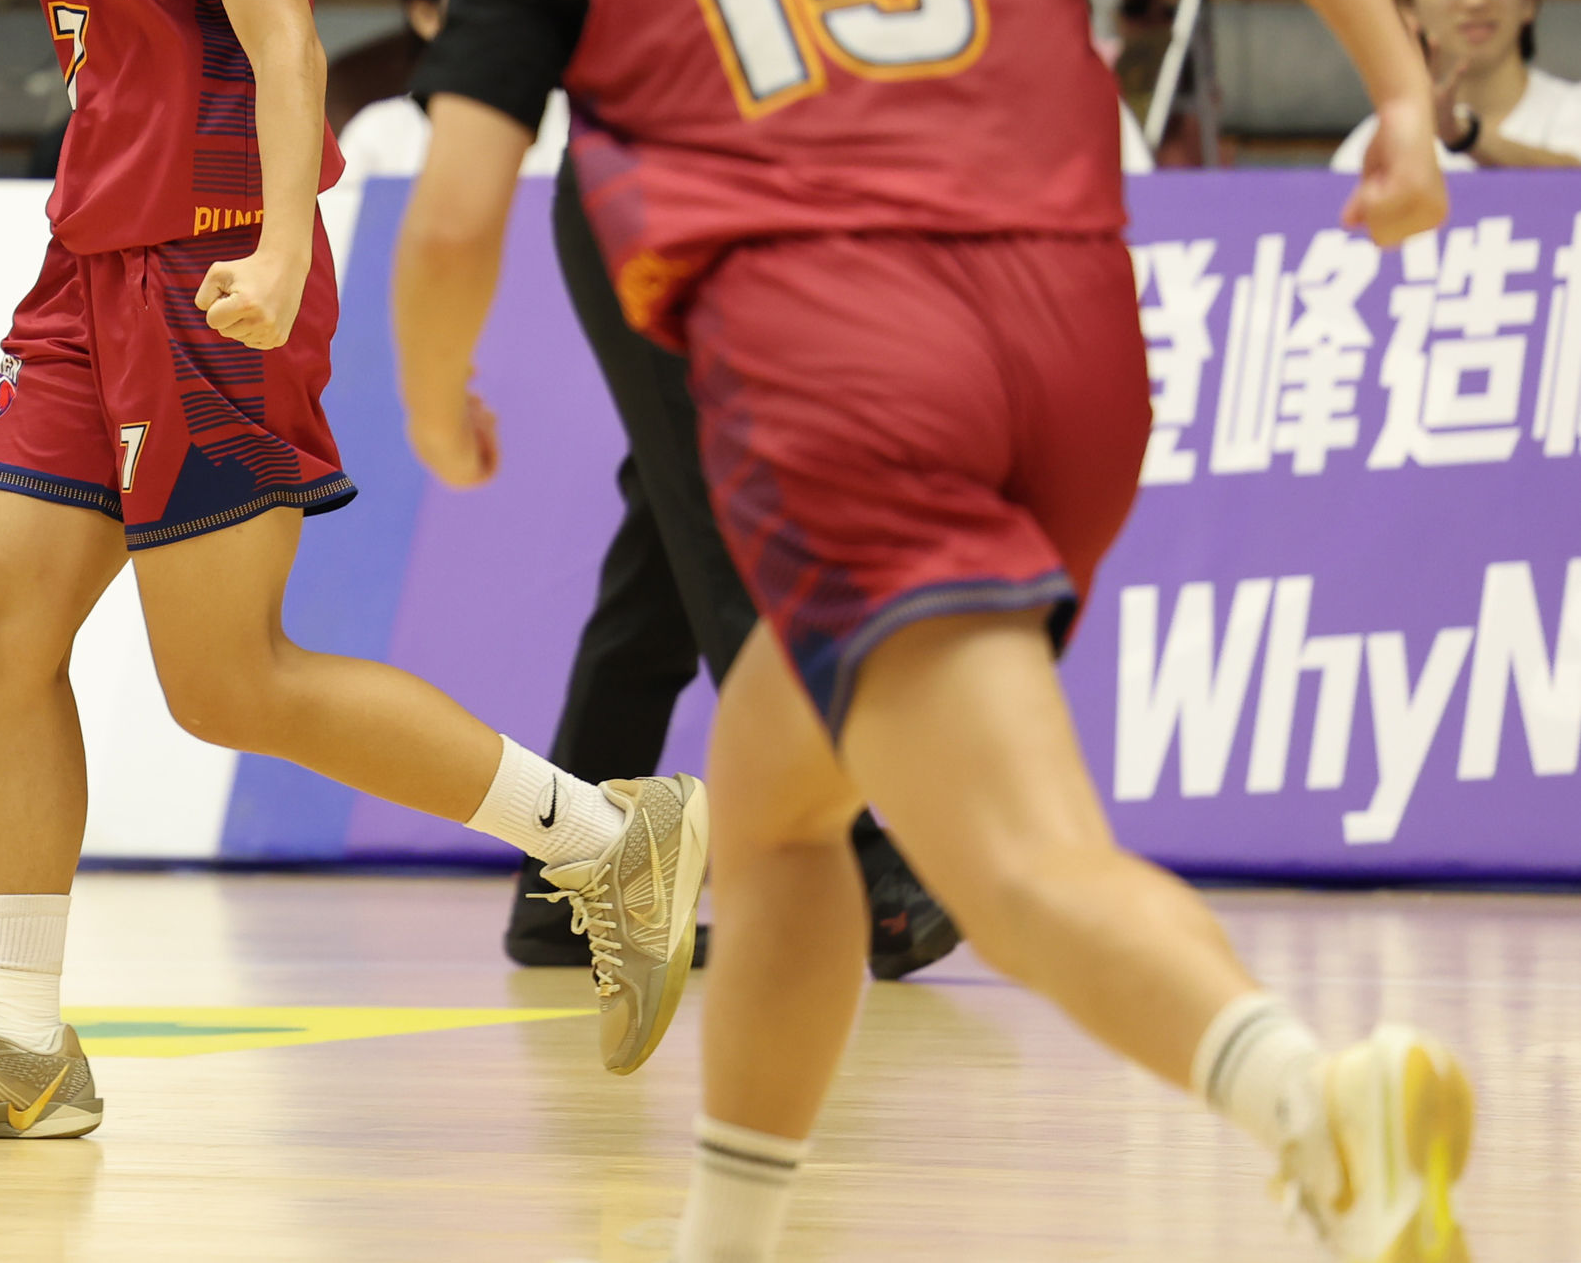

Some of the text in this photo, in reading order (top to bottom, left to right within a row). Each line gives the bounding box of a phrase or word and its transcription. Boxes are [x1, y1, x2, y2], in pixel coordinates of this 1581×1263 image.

[47, 1, 90, 112] 7
[1126, 212, 1581, 487] 登峰造
[119, 421, 151, 494] 7
